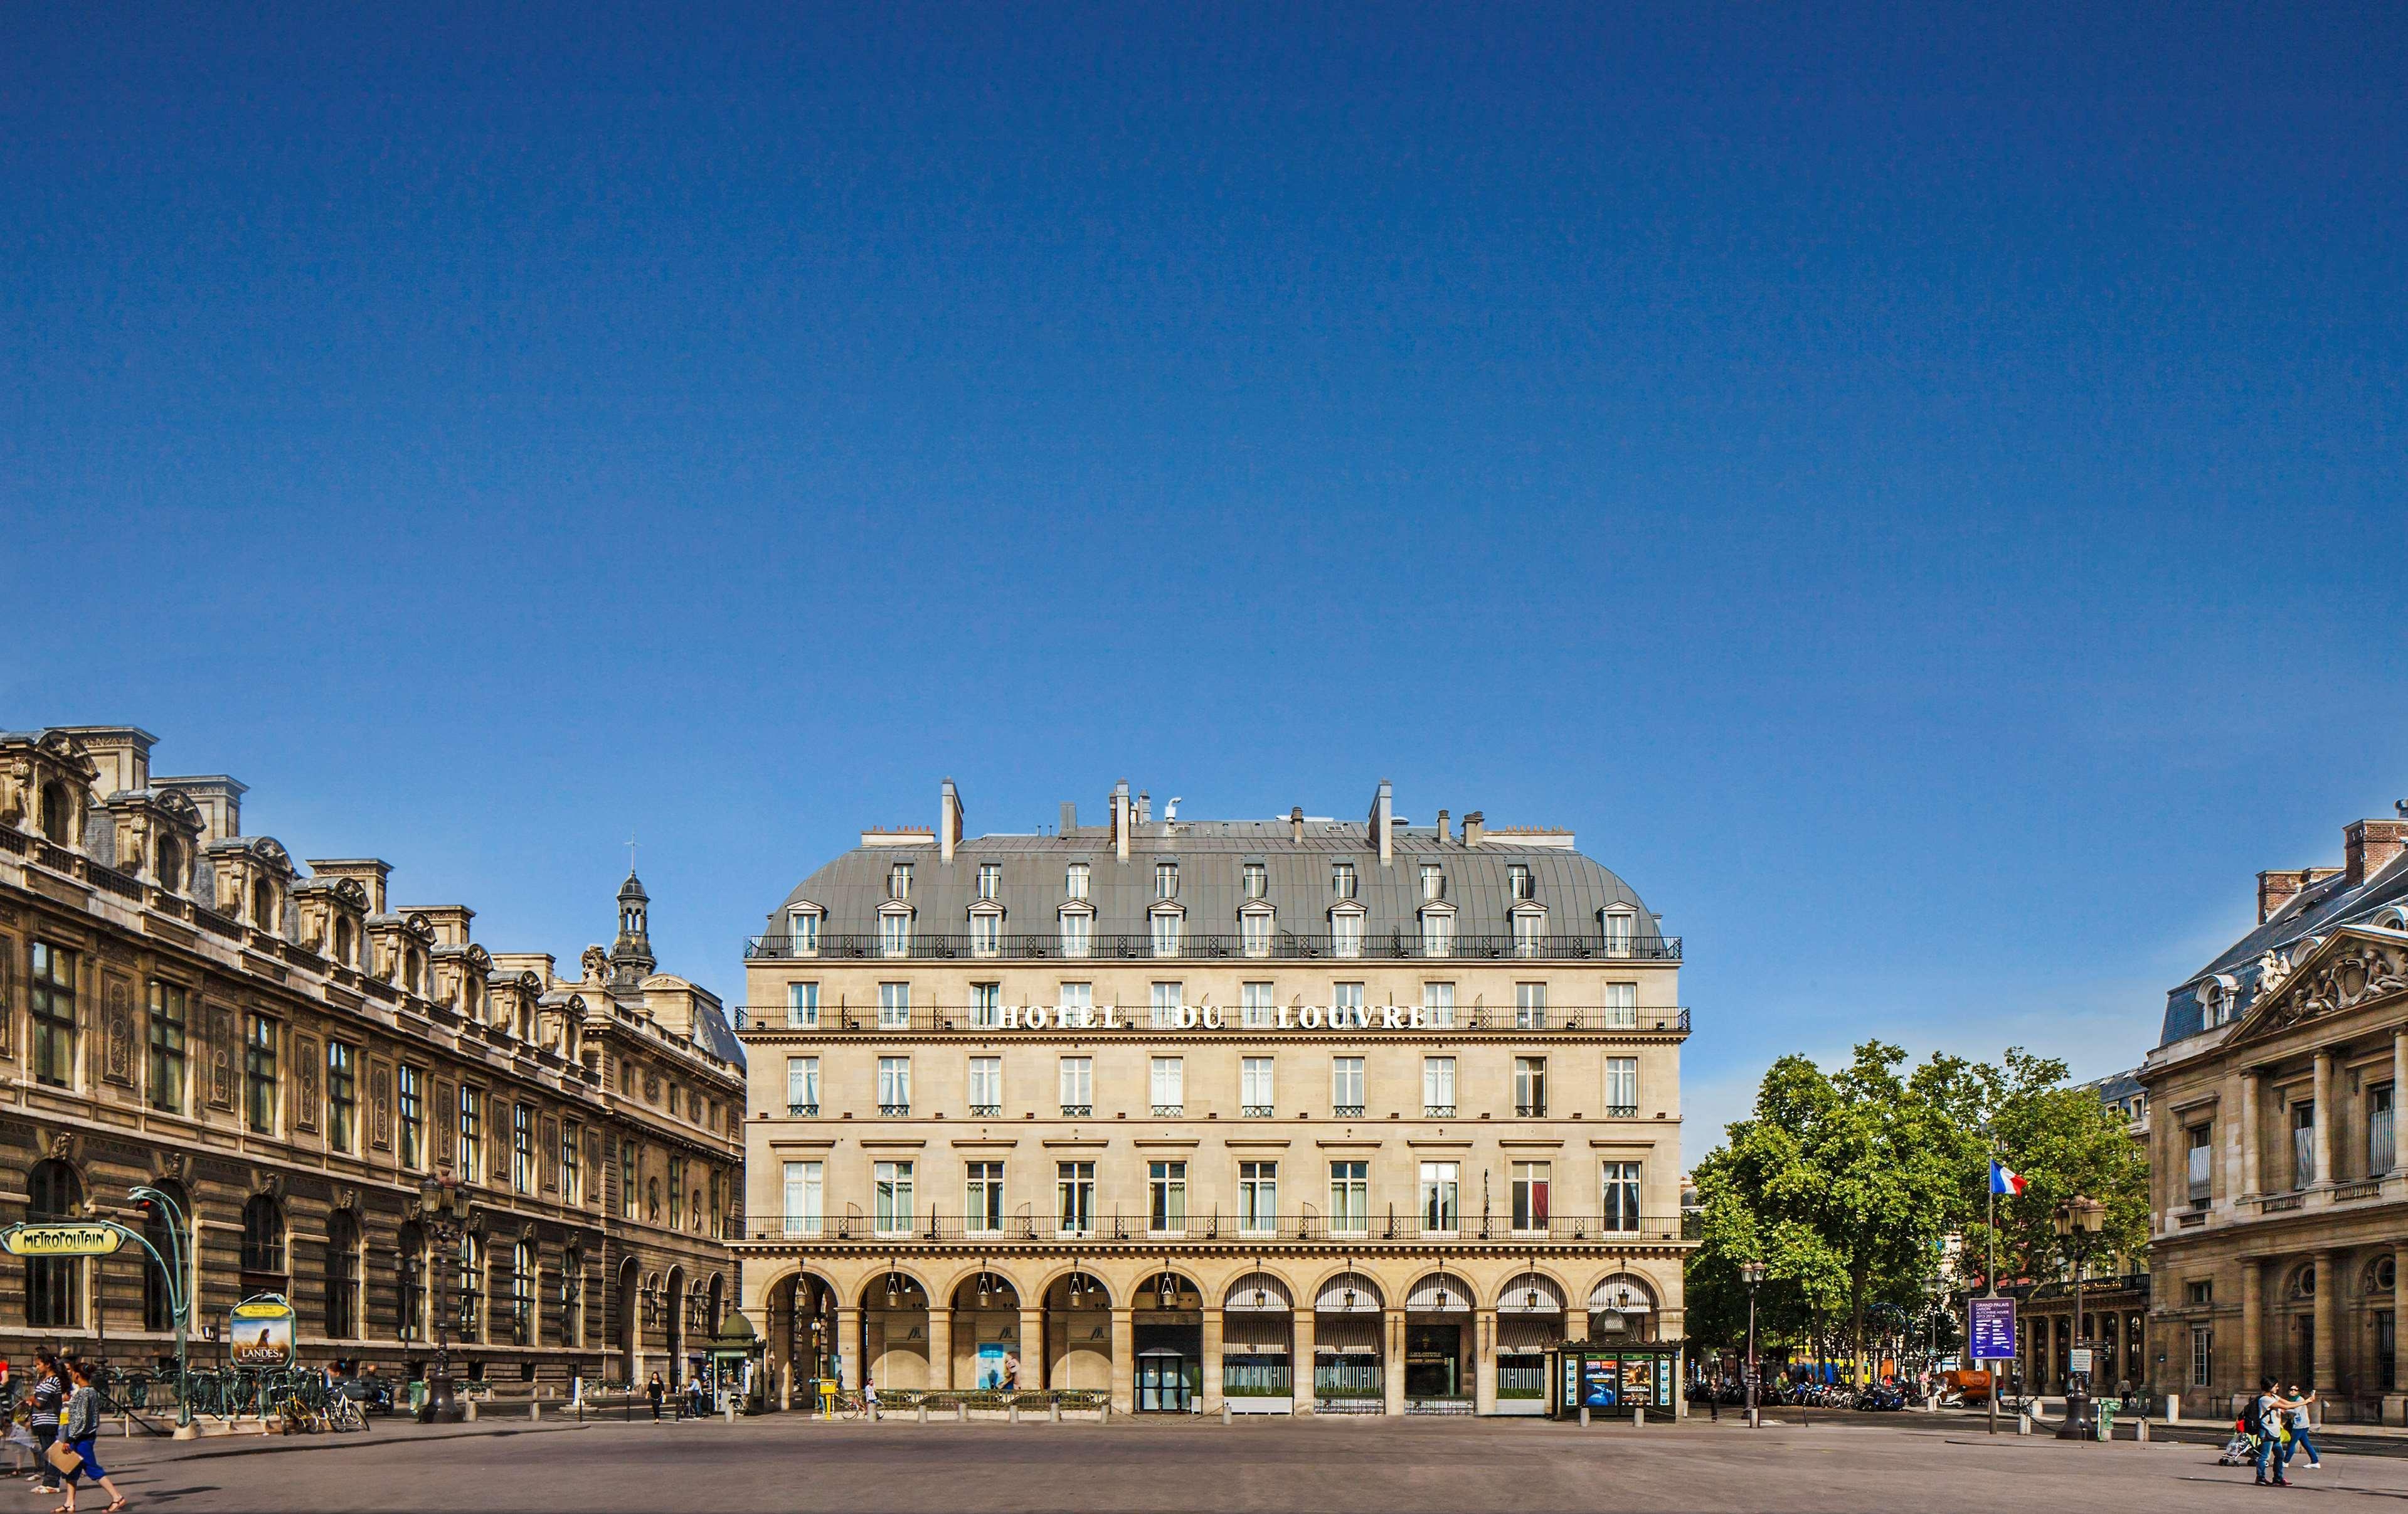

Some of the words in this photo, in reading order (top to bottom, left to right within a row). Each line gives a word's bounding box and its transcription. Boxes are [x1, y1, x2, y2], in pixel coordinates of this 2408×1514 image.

[996, 1006, 1122, 1029] HOTEL
[1174, 1006, 1224, 1029] DU
[1276, 1006, 1426, 1029] LOUVRE
[24, 1230, 104, 1249] METROPOLITAIN
[241, 1349, 280, 1358] LANDES
